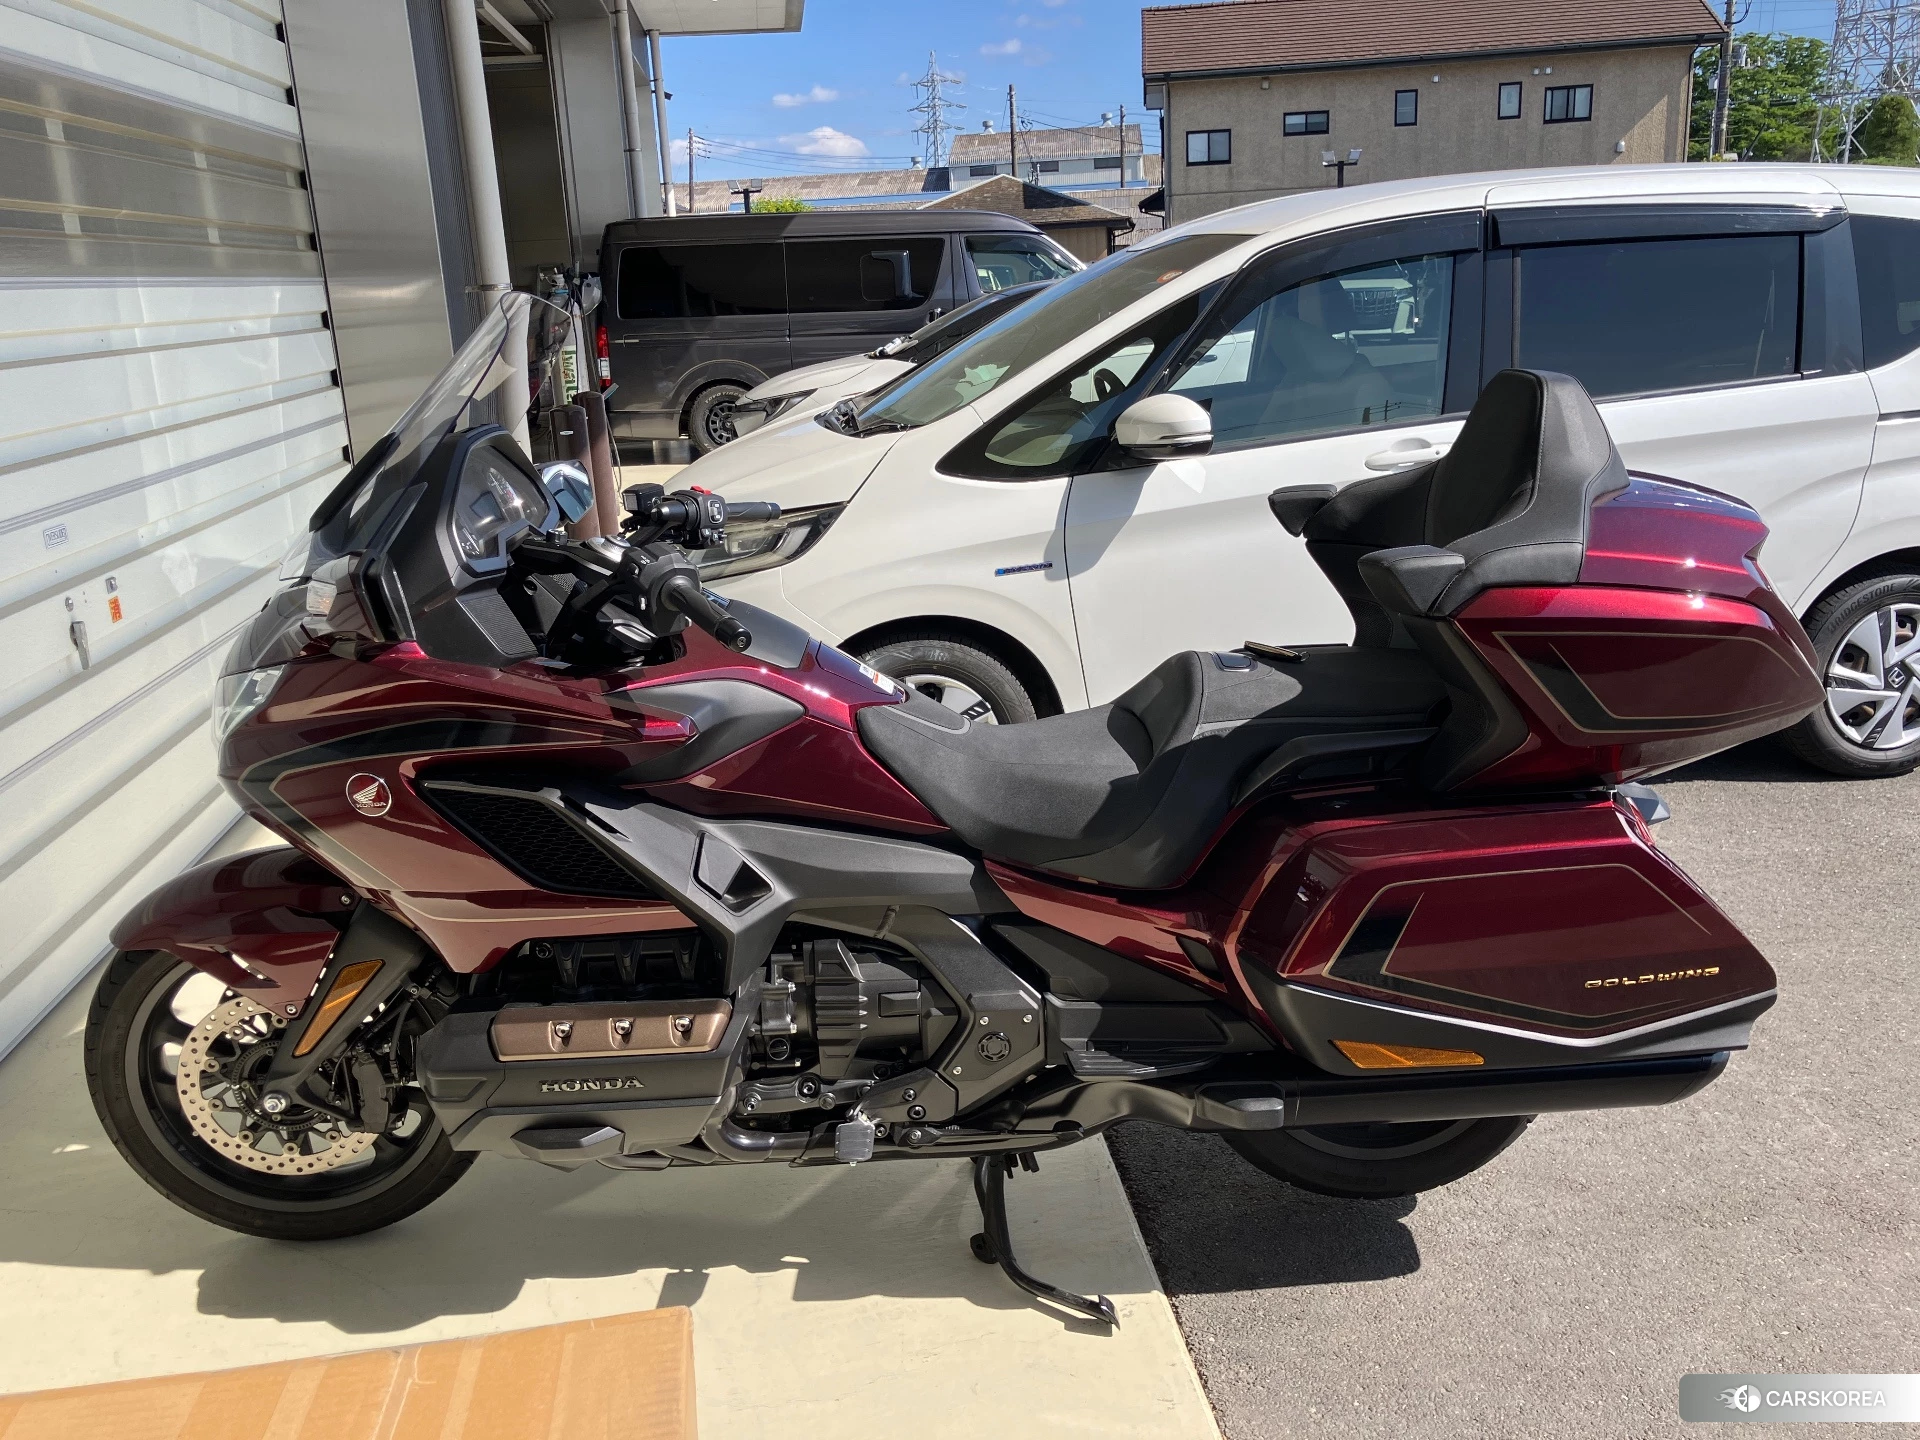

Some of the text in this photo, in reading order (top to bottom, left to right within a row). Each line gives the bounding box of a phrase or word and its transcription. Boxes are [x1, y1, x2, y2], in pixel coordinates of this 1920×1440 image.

[1828, 582, 1896, 634] BRIDGESTONE
[1585, 967, 1720, 988] GOLDWING
[540, 1076, 645, 1093] HONDA
